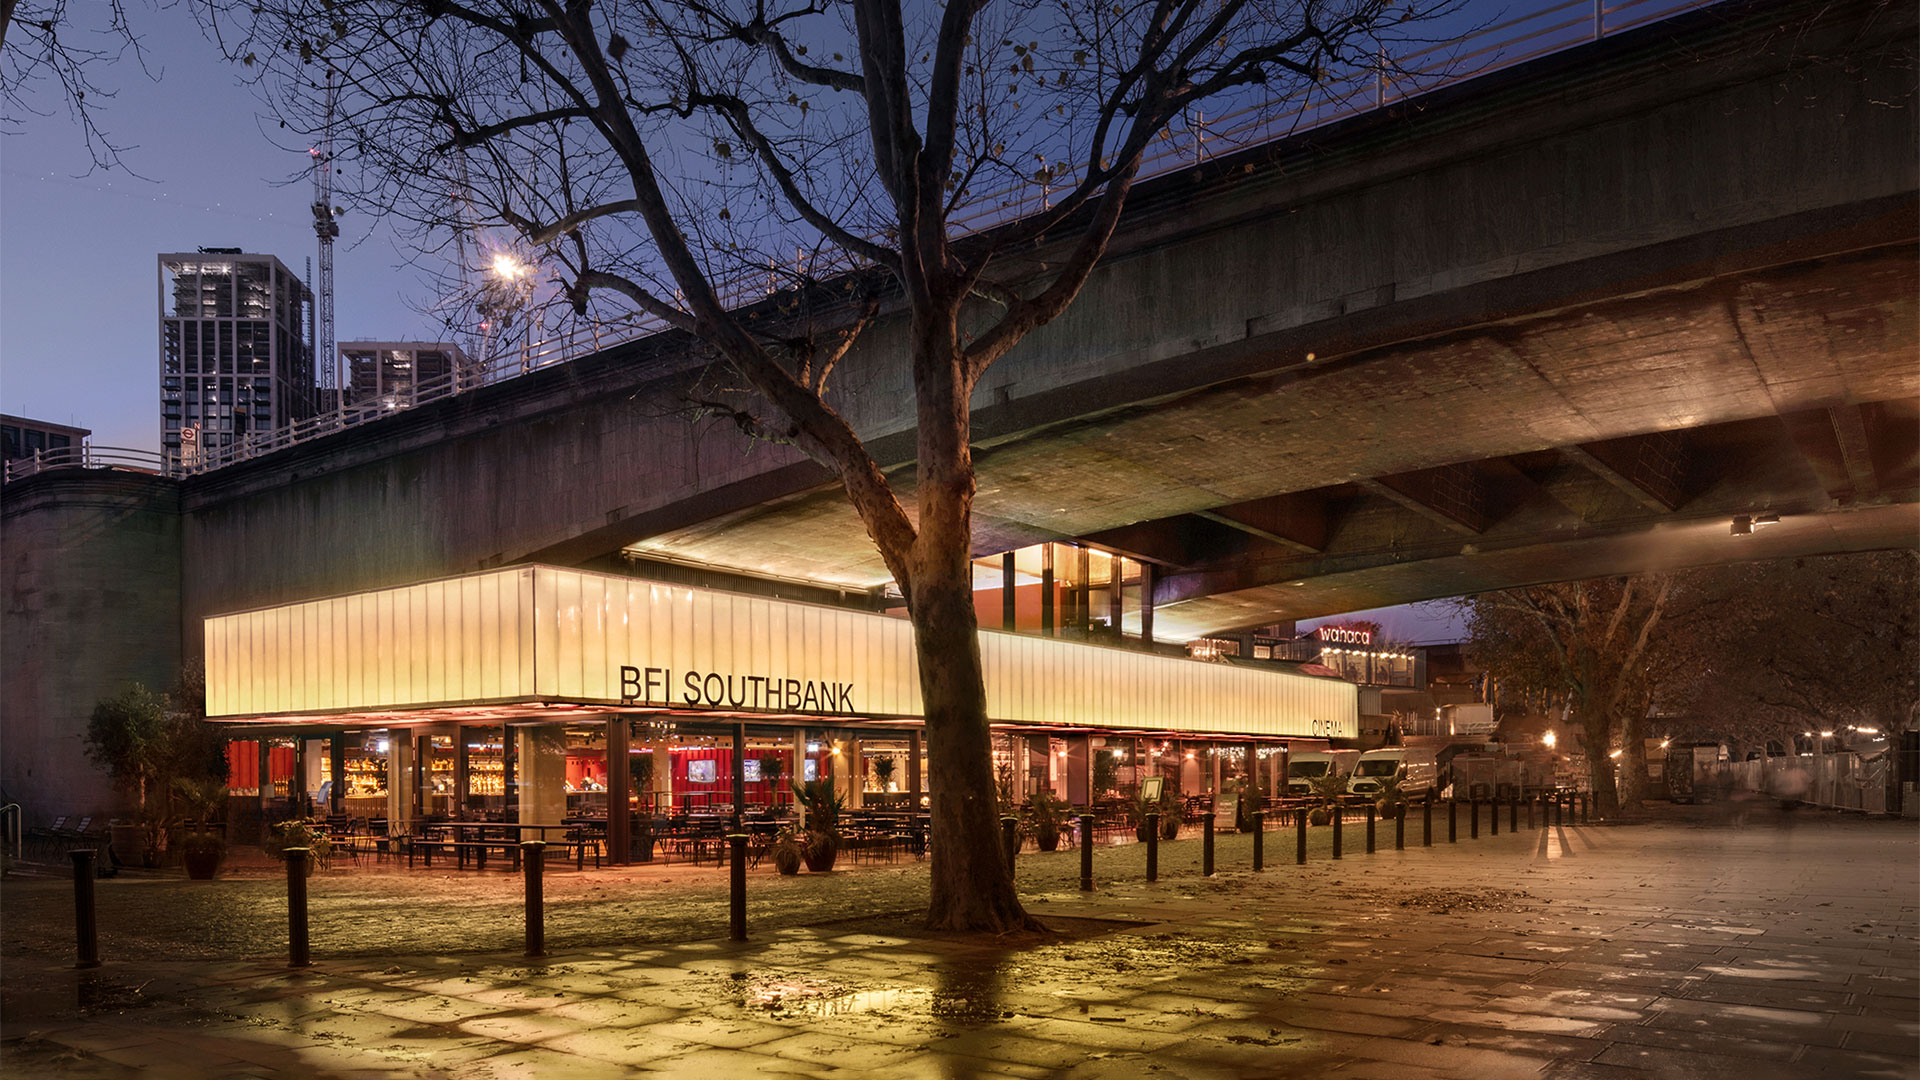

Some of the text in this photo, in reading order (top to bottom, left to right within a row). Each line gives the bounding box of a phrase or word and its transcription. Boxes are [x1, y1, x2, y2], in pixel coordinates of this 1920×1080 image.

[1319, 626, 1370, 644] wahaca
[620, 665, 854, 713] BFI SOUTHBANK
[1311, 719, 1342, 737] CINEMA
